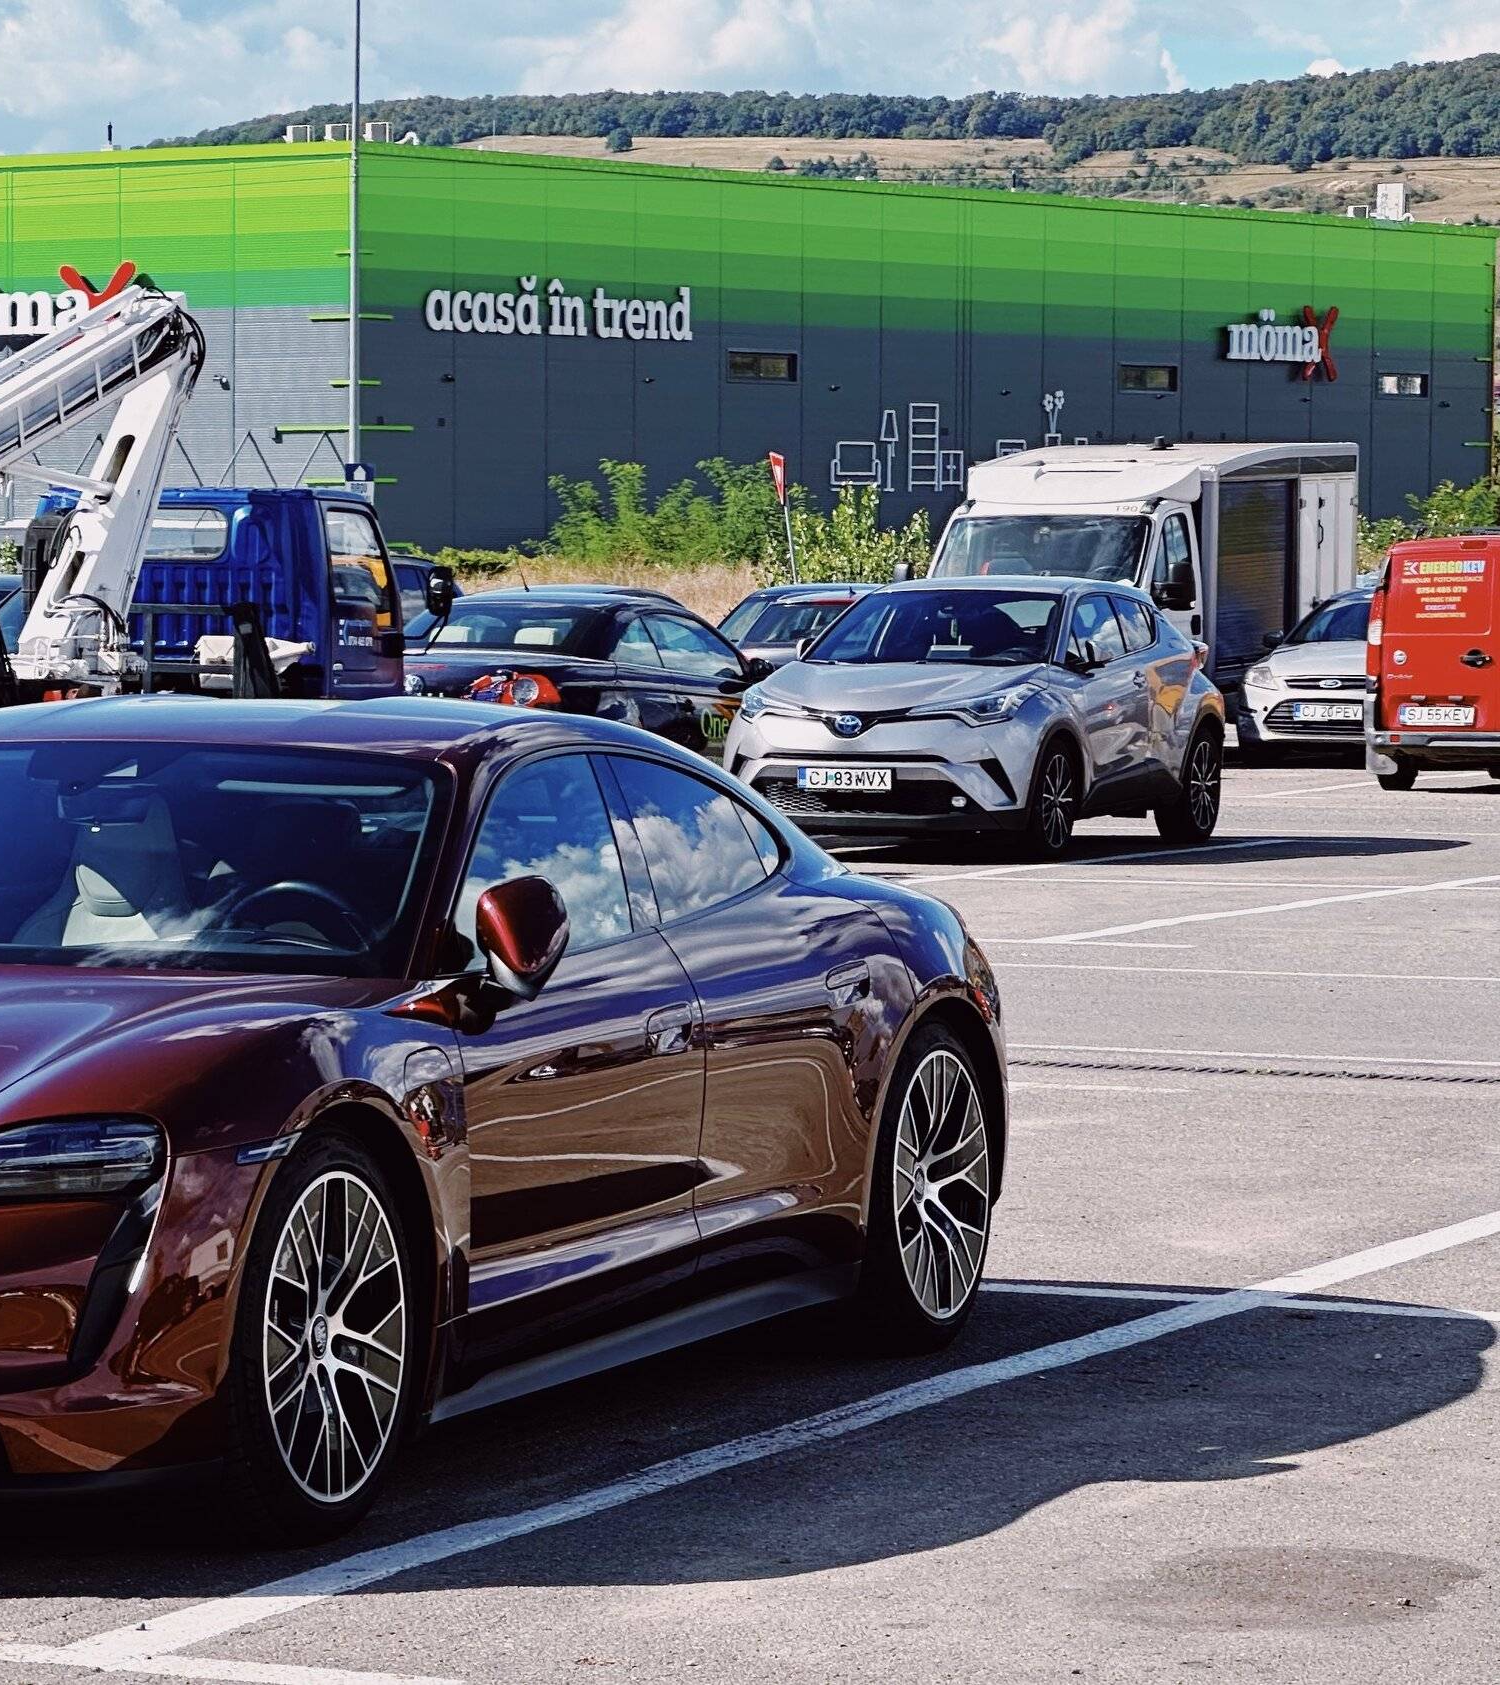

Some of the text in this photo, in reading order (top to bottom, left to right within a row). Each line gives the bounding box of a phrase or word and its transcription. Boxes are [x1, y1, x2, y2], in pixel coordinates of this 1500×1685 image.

[425, 275, 693, 341] acasă în trend
[1407, 708, 1423, 721] SJ
[809, 771, 828, 786] CJ
